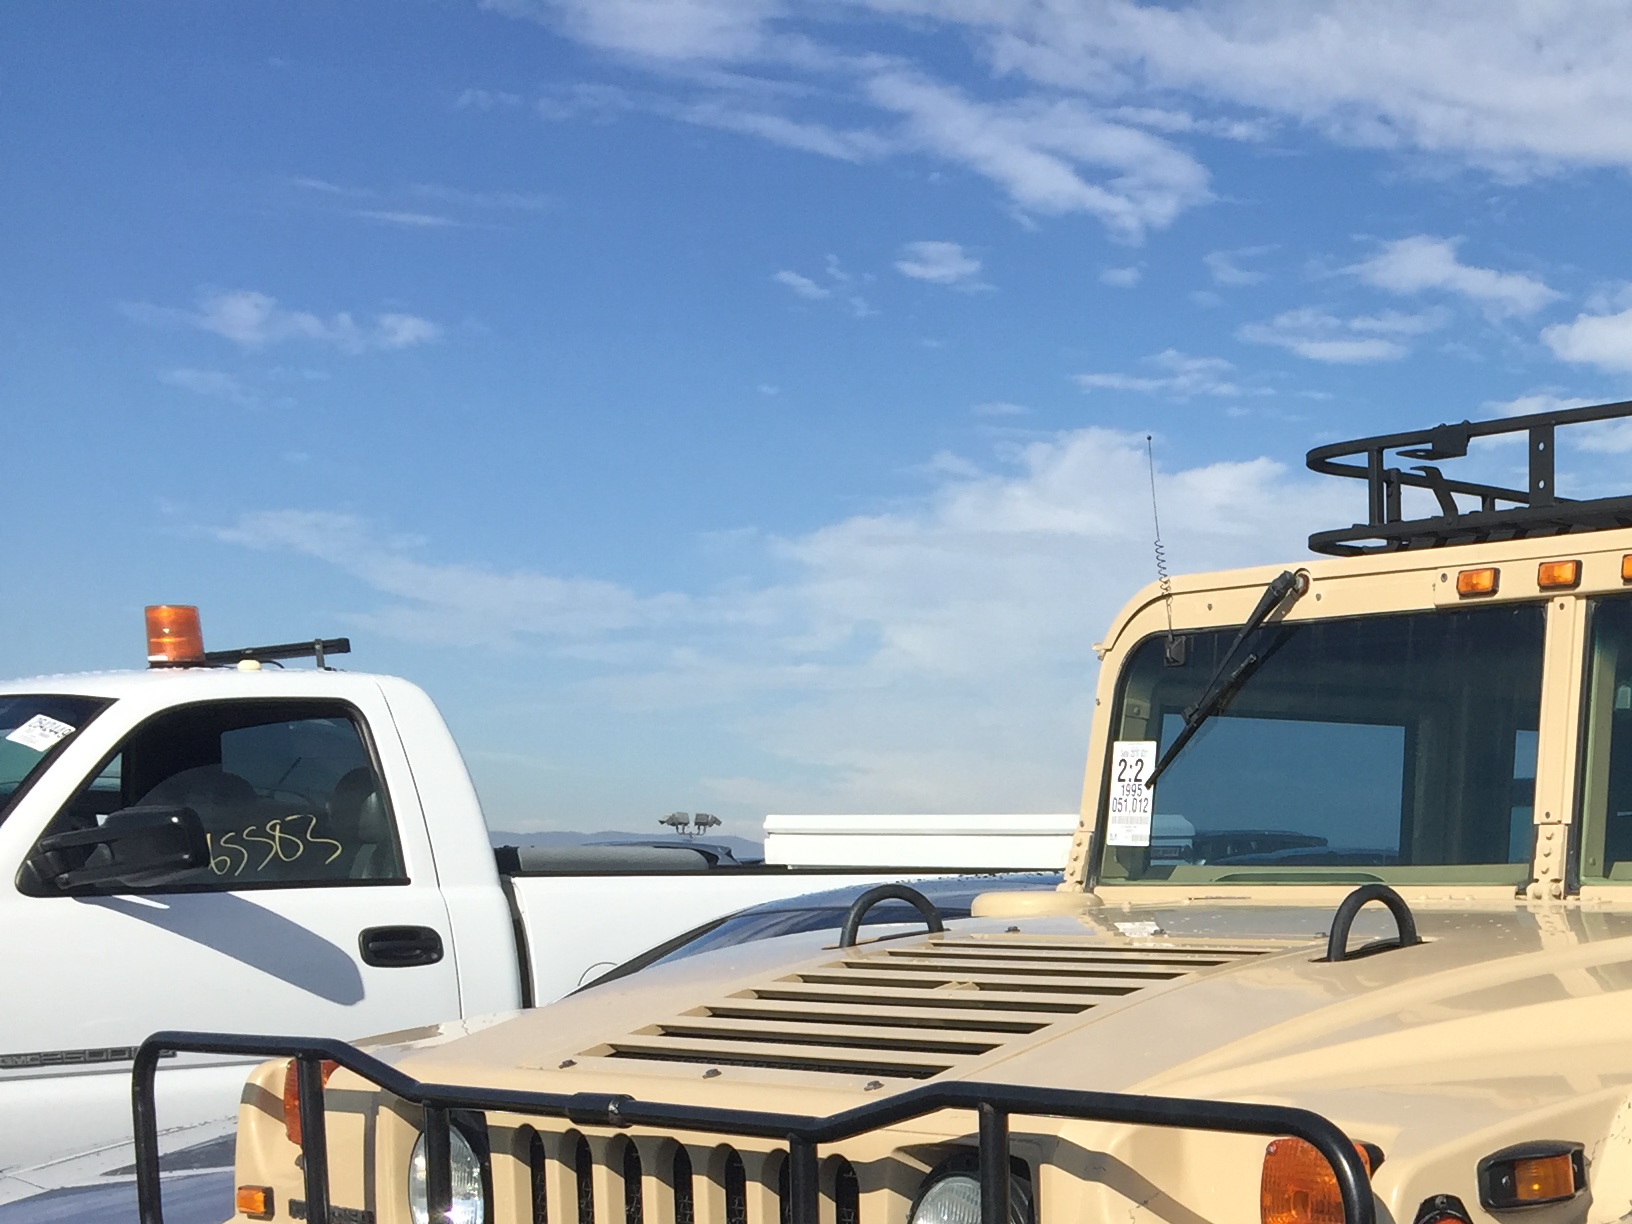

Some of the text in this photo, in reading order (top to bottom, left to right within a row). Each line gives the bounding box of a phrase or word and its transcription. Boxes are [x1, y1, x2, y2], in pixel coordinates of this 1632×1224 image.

[1117, 758, 1145, 783] 2:2
[1121, 784, 1143, 797] 1995
[41, 1047, 174, 1064] 2500
